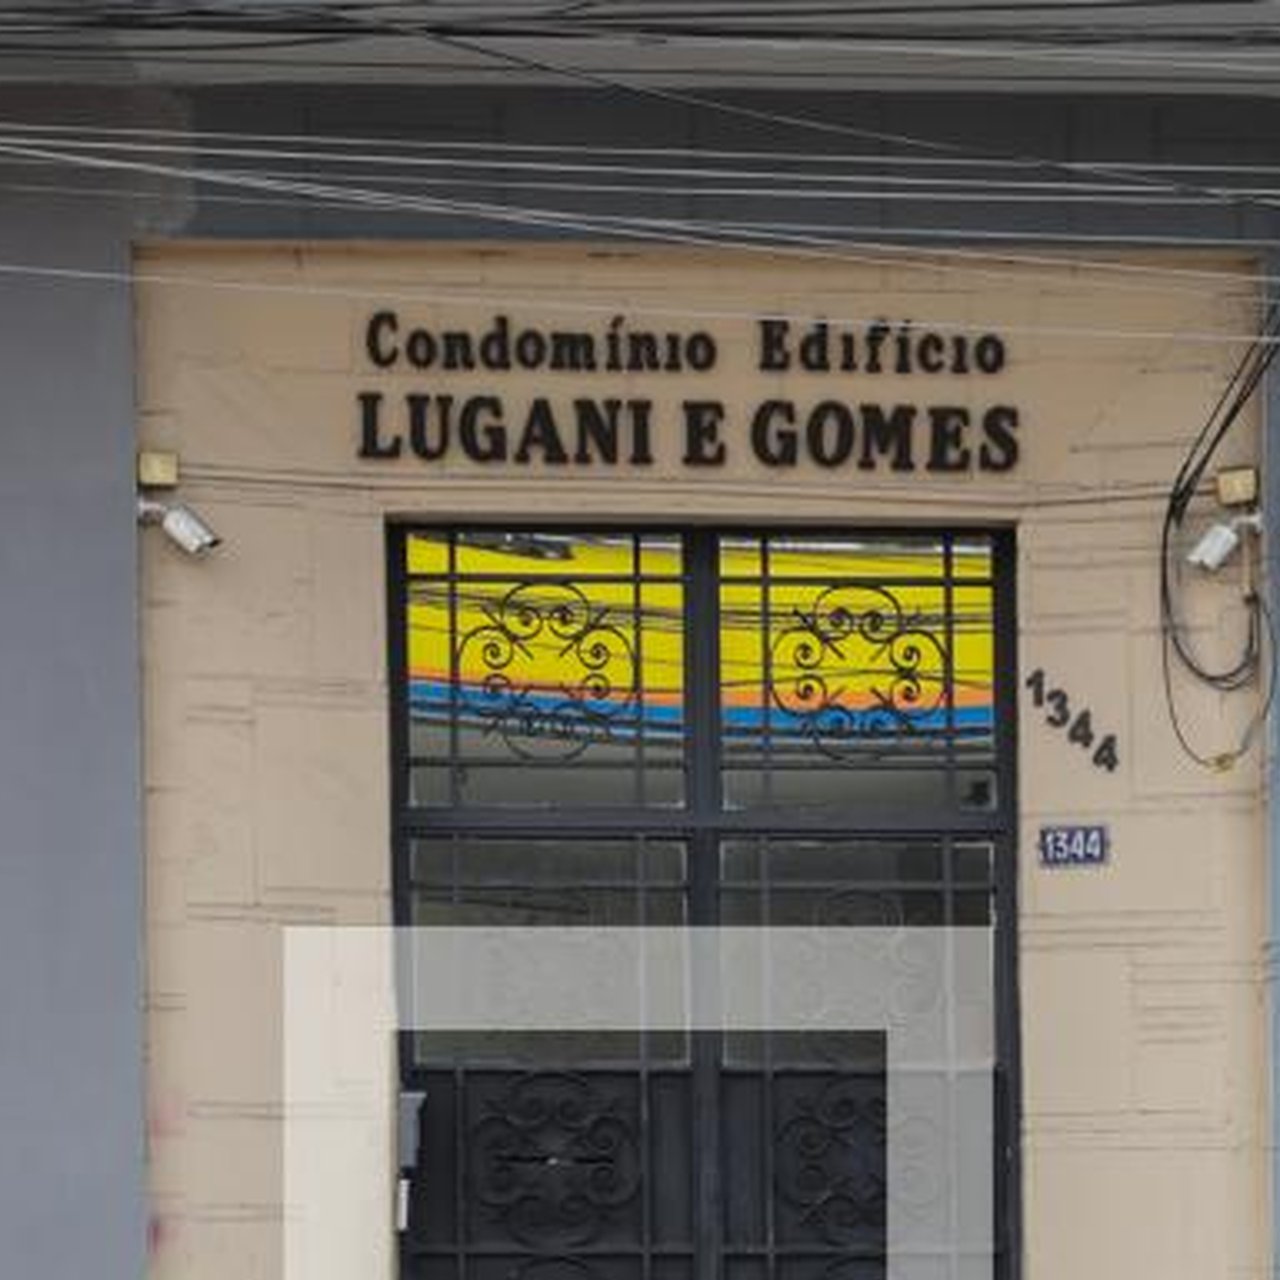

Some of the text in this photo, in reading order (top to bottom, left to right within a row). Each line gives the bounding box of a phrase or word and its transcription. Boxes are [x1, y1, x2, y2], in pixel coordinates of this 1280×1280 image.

[365, 313, 718, 374] Condomínio
[356, 392, 1021, 474] LUGANI E GOMES
[1025, 667, 1119, 772] 1344
[1045, 829, 1102, 860] 1344
